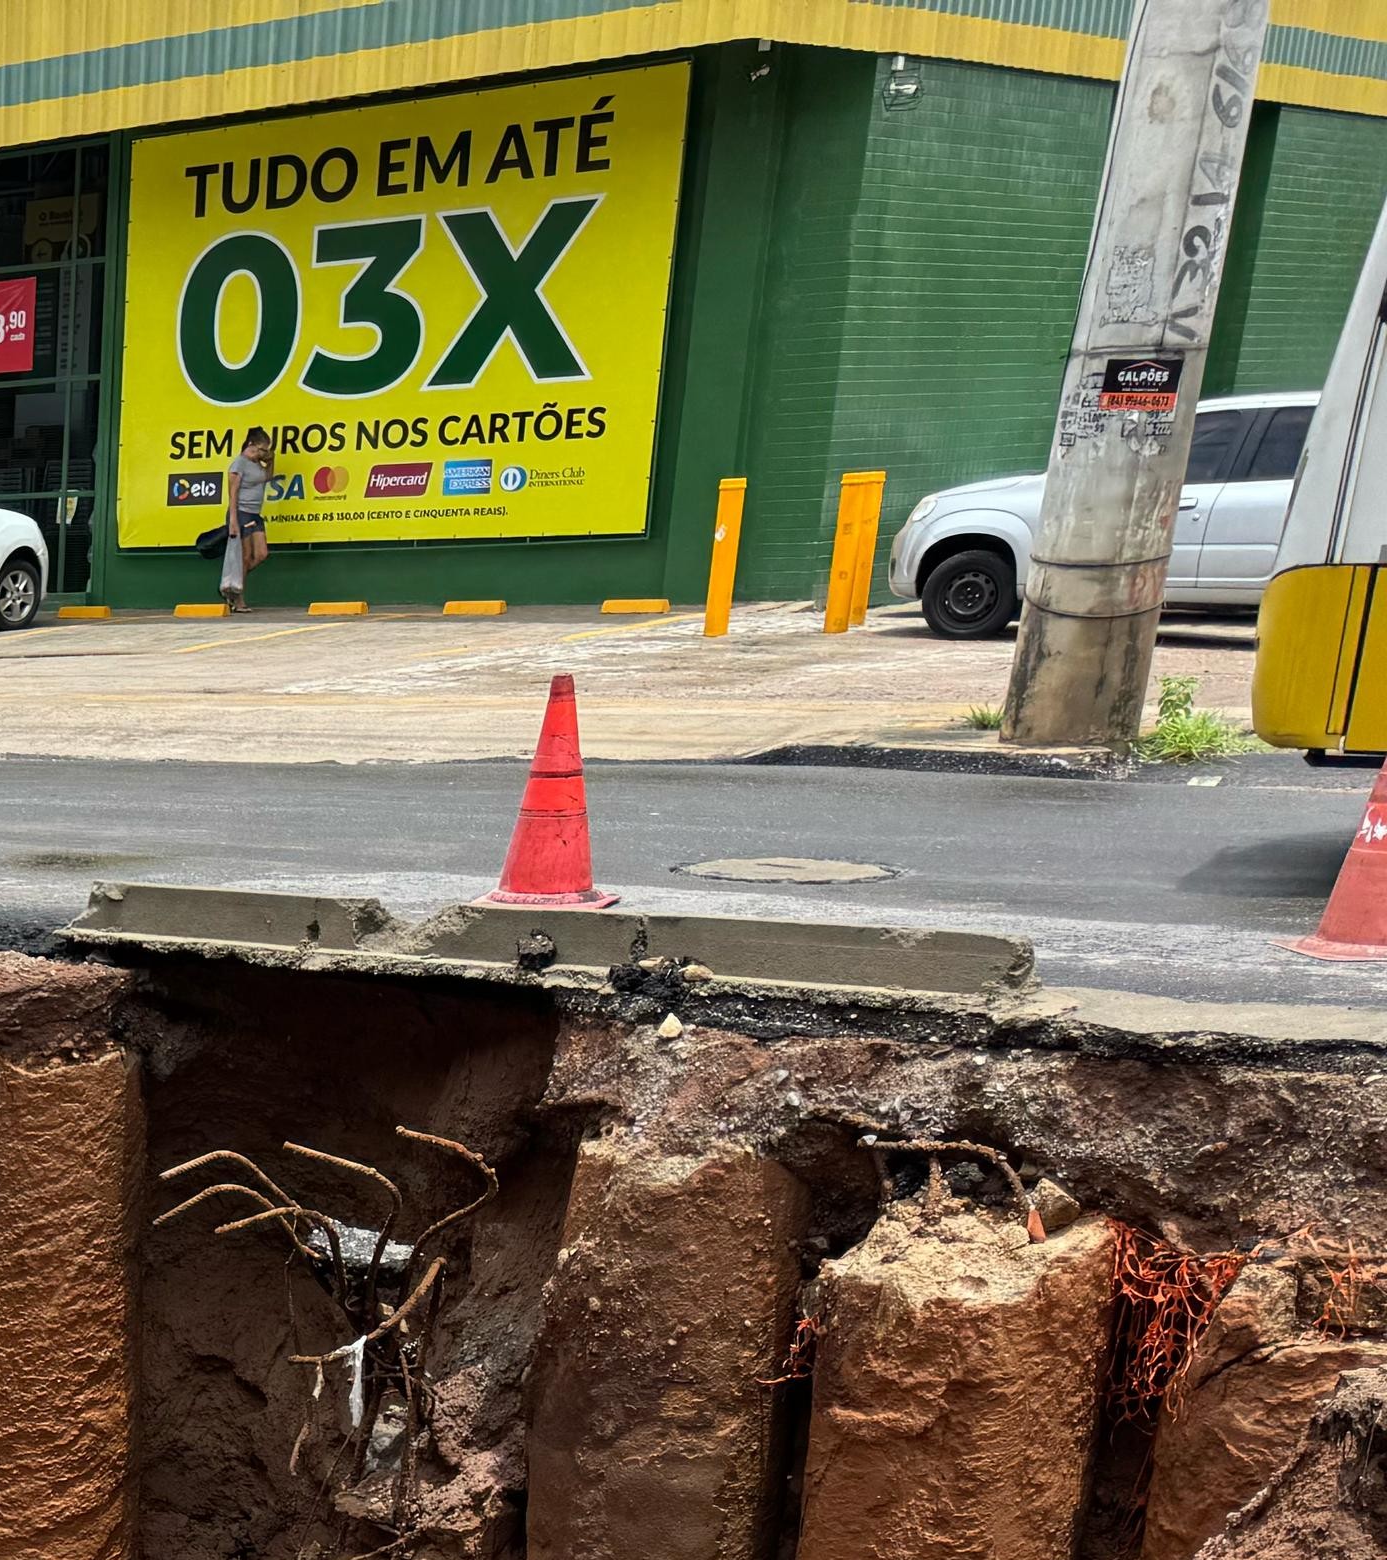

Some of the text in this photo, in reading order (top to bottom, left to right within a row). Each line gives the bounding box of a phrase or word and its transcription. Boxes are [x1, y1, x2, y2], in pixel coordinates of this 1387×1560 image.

[185, 94, 616, 218] TUDO EM ATÉ
[176, 191, 606, 407] 03X
[1117, 368, 1169, 382] GALPÕES
[169, 428, 233, 461] SEM
[356, 417, 429, 451] NOS
[438, 402, 607, 446] CARTÕES
[369, 471, 428, 488] Hipercard
[529, 467, 585, 480] Diners Club
[190, 478, 217, 498] elo
[450, 479, 491, 489] EXPRESS
[307, 512, 320, 522] DE
[323, 512, 334, 522] R$
[367, 509, 403, 521] (CENTO
[405, 509, 411, 518] E
[413, 508, 471, 519] CINQUENTA
